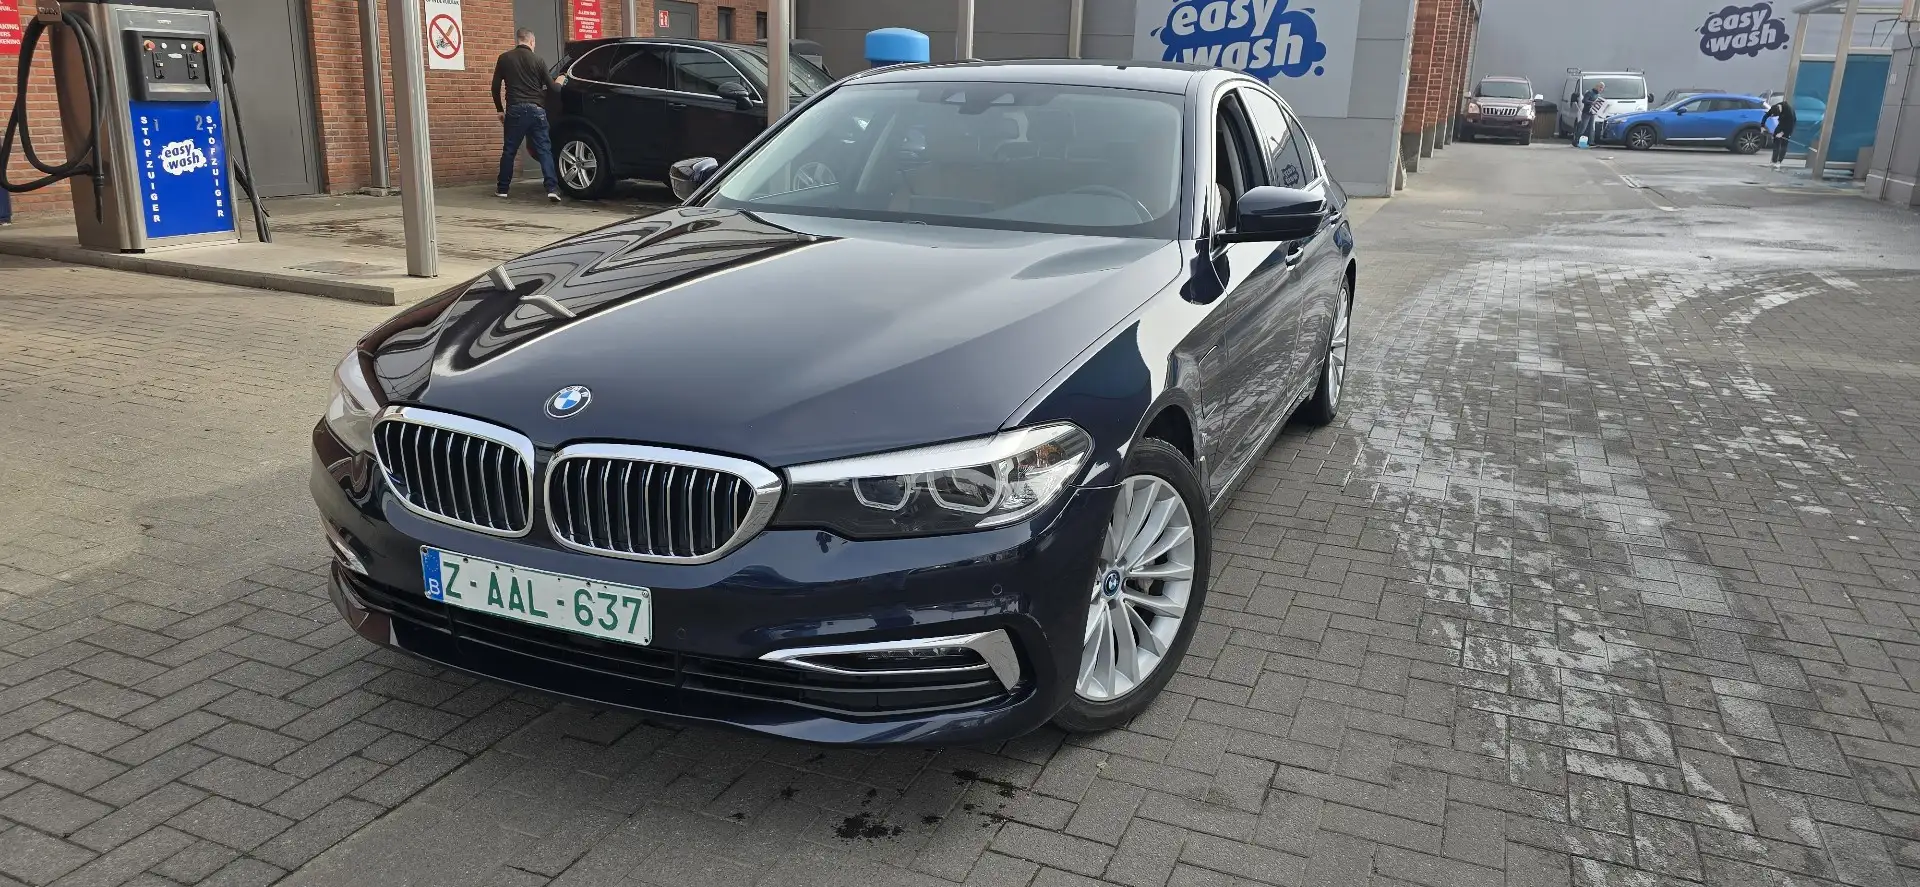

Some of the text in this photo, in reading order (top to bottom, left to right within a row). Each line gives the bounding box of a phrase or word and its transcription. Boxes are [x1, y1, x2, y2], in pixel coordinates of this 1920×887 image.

[1171, 0, 1282, 37] easy
[1707, 9, 1768, 33] easy
[1182, 23, 1304, 71] wash
[1710, 23, 1777, 53] wash
[195, 114, 203, 131] 2
[164, 143, 192, 158] easy
[168, 152, 200, 170] wash
[140, 116, 161, 223] STOFZUIGER
[206, 115, 224, 217] STOFZUIGER
[428, 578, 441, 595] B
[443, 561, 642, 634] Z-AAL-637
